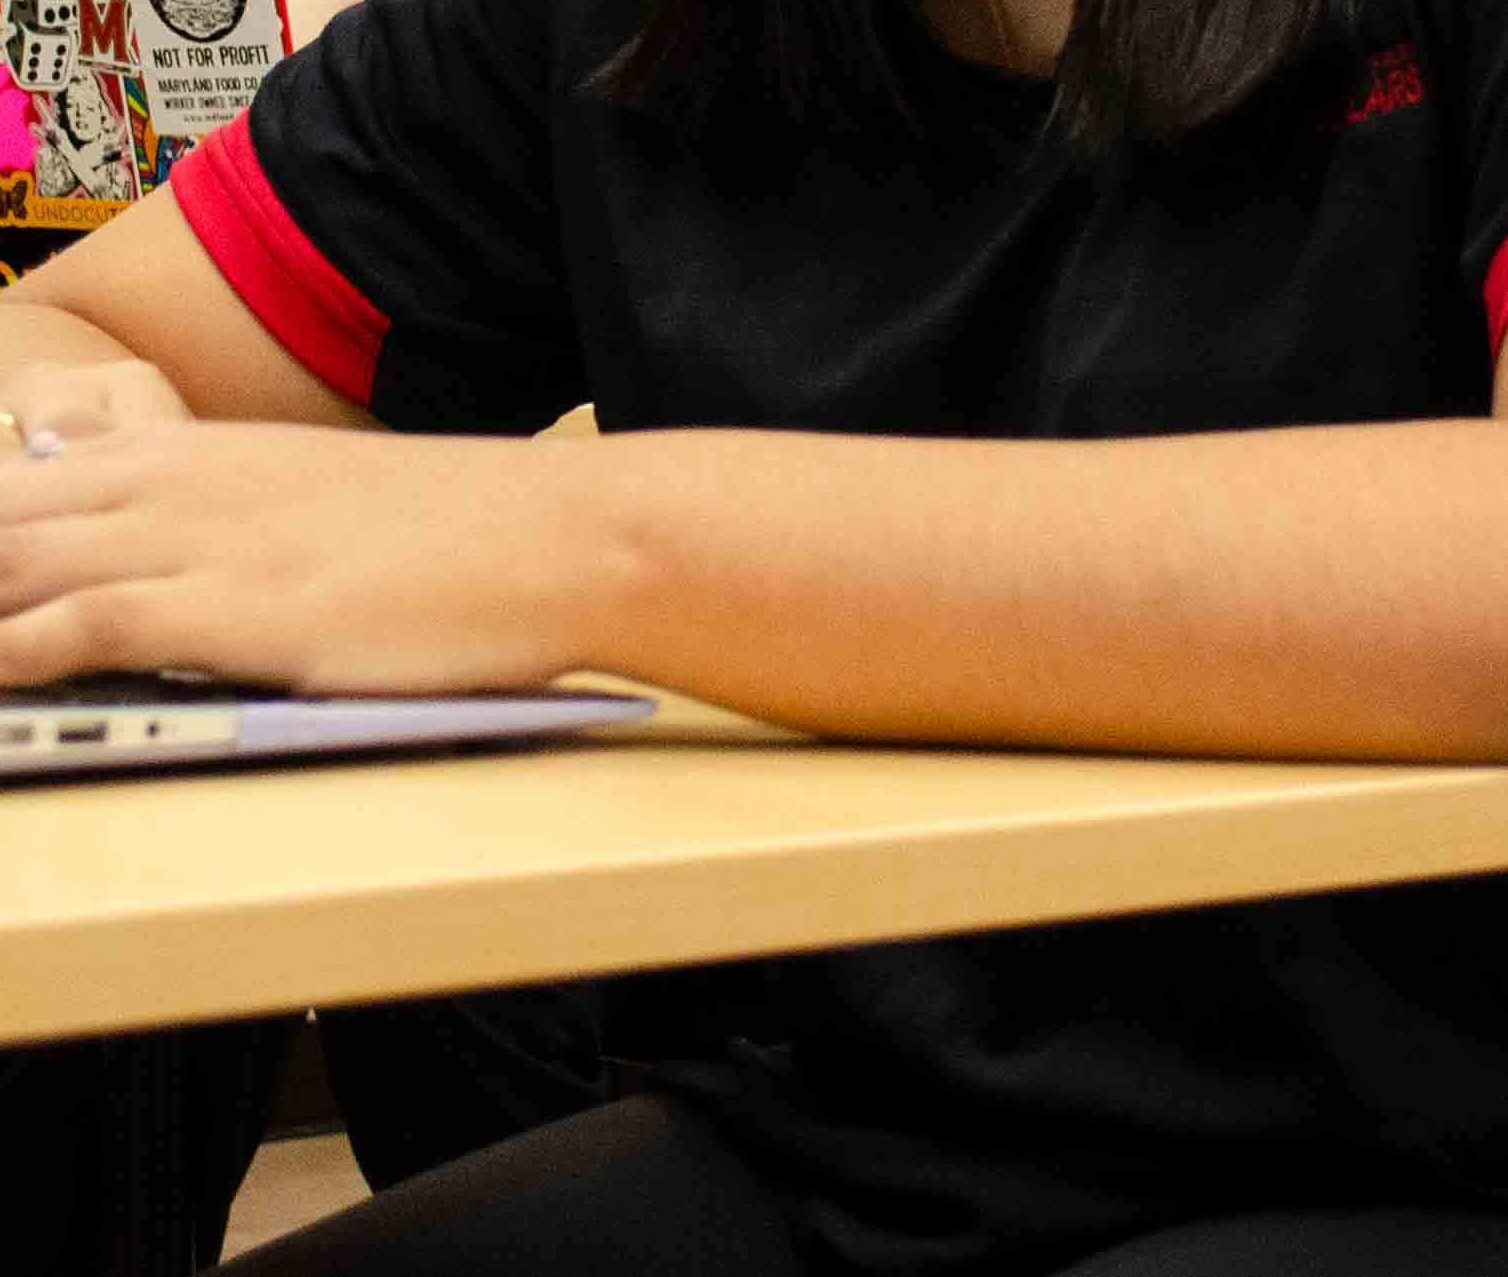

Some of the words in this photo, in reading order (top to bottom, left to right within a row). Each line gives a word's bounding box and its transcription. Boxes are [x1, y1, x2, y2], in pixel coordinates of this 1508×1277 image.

[152, 47, 181, 68] NOT
[187, 46, 215, 67] FOR
[219, 43, 270, 66] PROFIT
[157, 76, 212, 94] MARYLAND
[215, 76, 242, 93] FOOD
